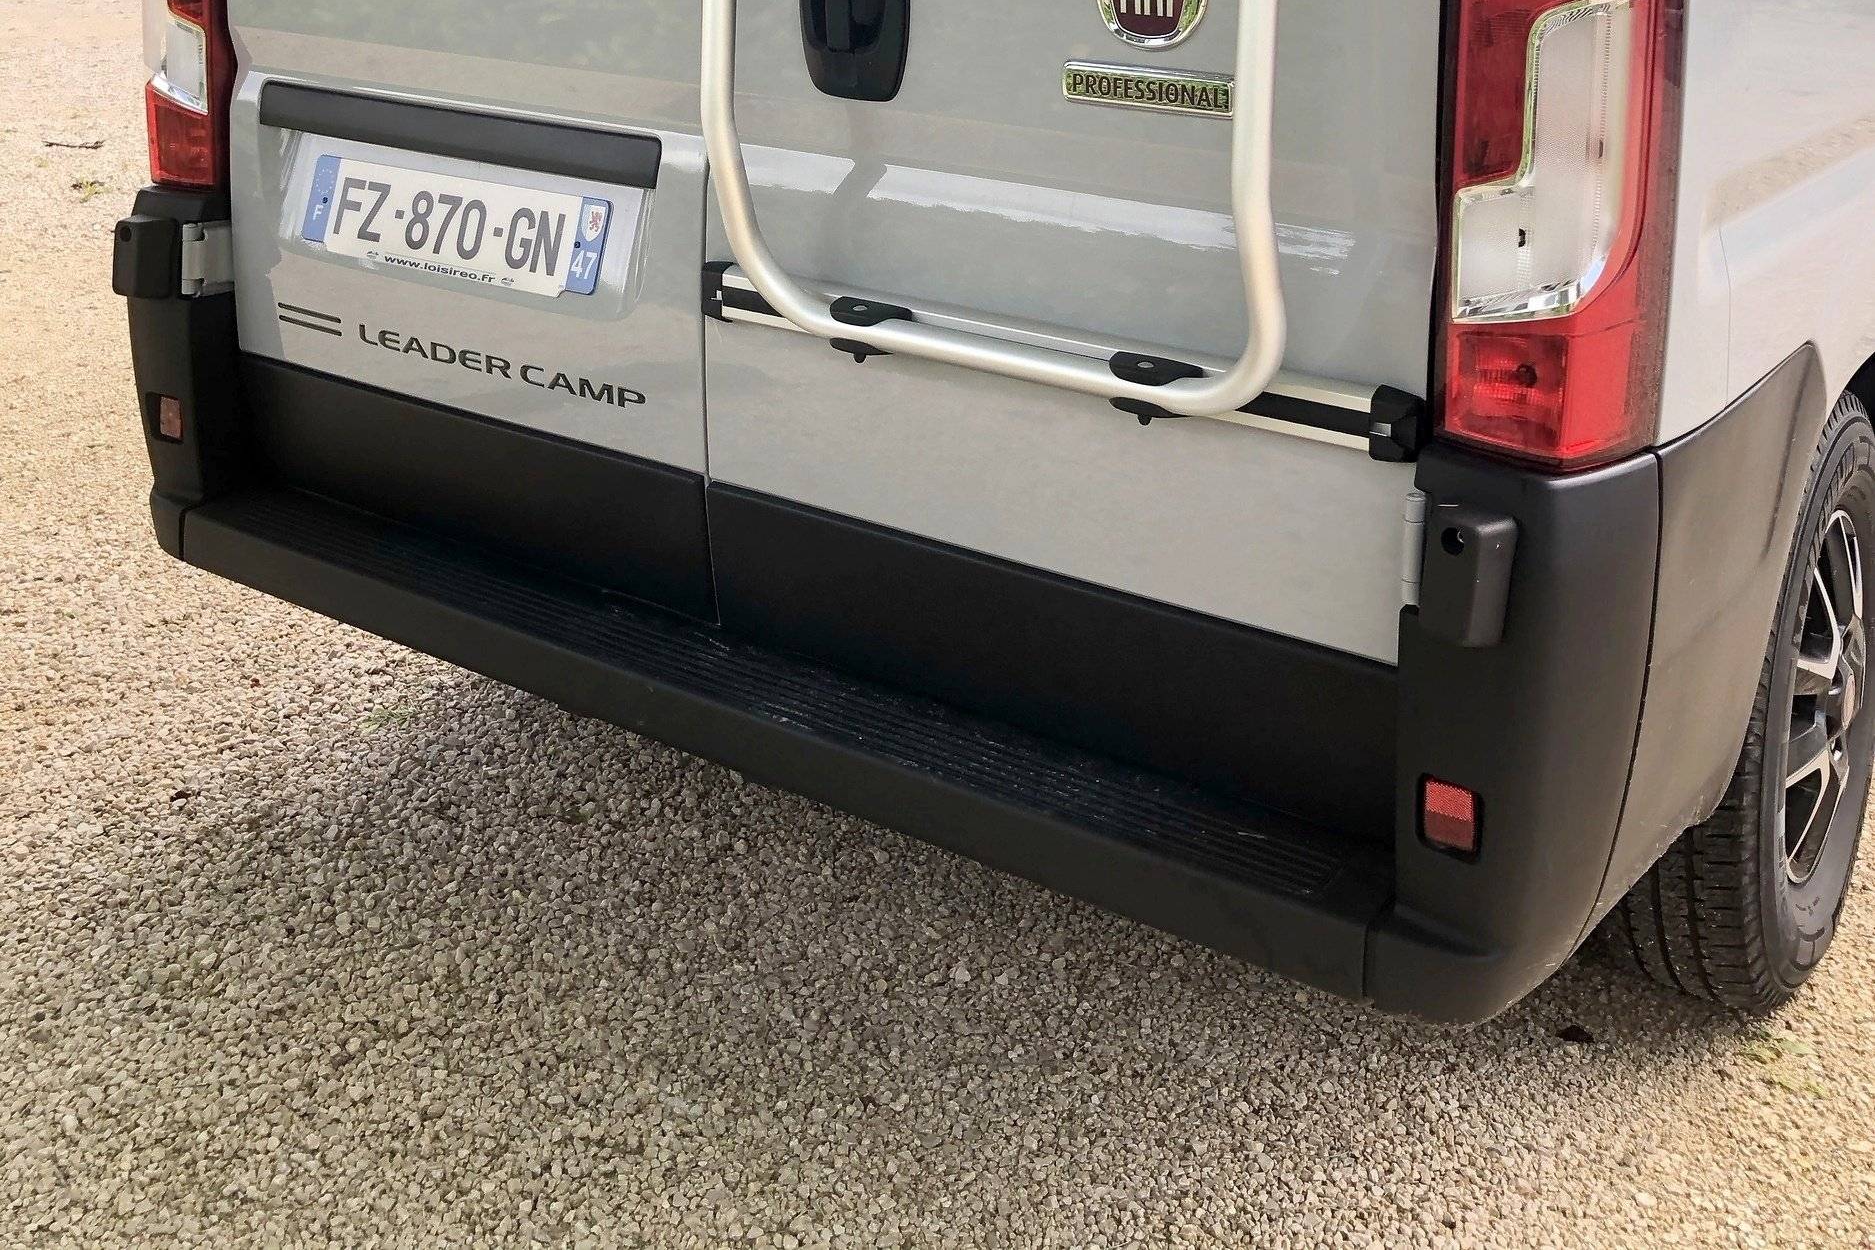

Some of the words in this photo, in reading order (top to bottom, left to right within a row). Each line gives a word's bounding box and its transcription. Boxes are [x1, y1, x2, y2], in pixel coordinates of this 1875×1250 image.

[1072, 73, 1225, 109] PROFESSIONAL
[312, 204, 324, 221] F
[332, 177, 566, 277] FZ-870-GN
[384, 254, 496, 284] www.loisireo.fr
[570, 251, 597, 280] 47
[358, 323, 513, 380] LEADER
[519, 363, 647, 409] CAMP
